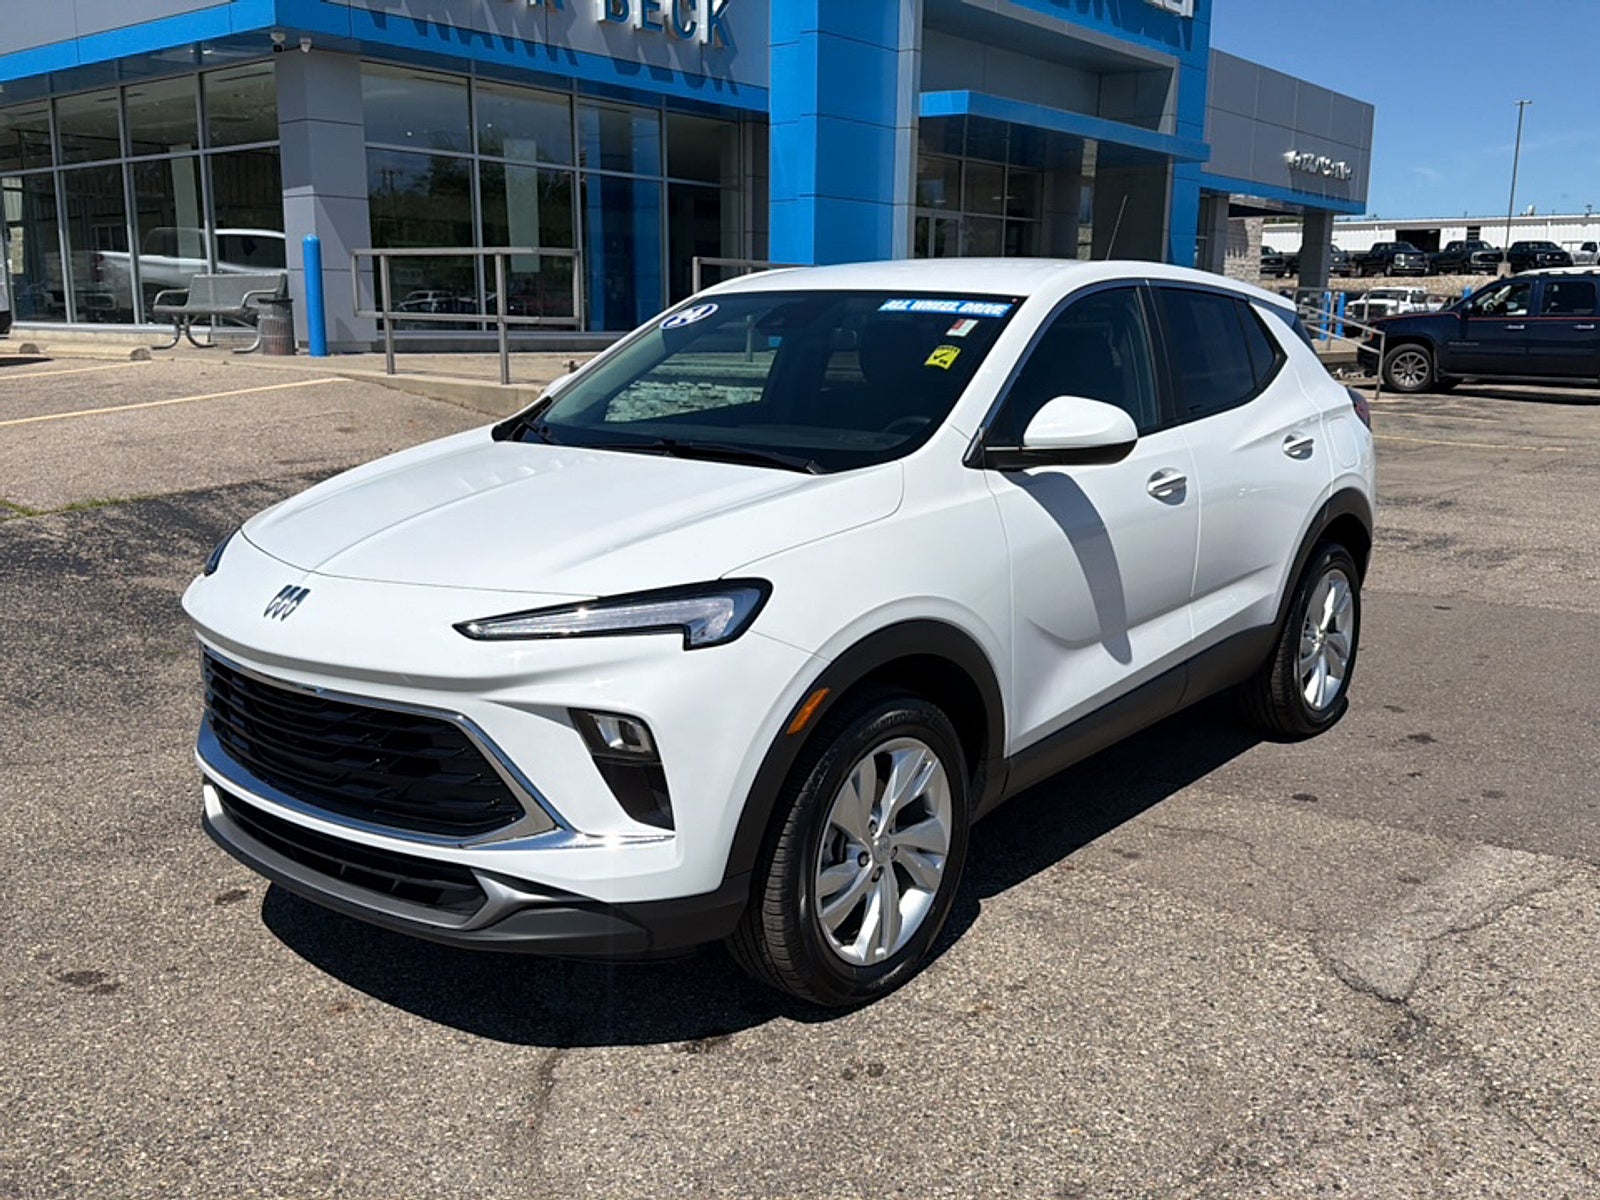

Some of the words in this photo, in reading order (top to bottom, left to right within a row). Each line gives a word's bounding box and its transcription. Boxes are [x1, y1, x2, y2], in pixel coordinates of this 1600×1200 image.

[880, 299, 908, 311] ALL
[911, 300, 958, 313] WHEEL
[960, 302, 1007, 316] DRIVE
